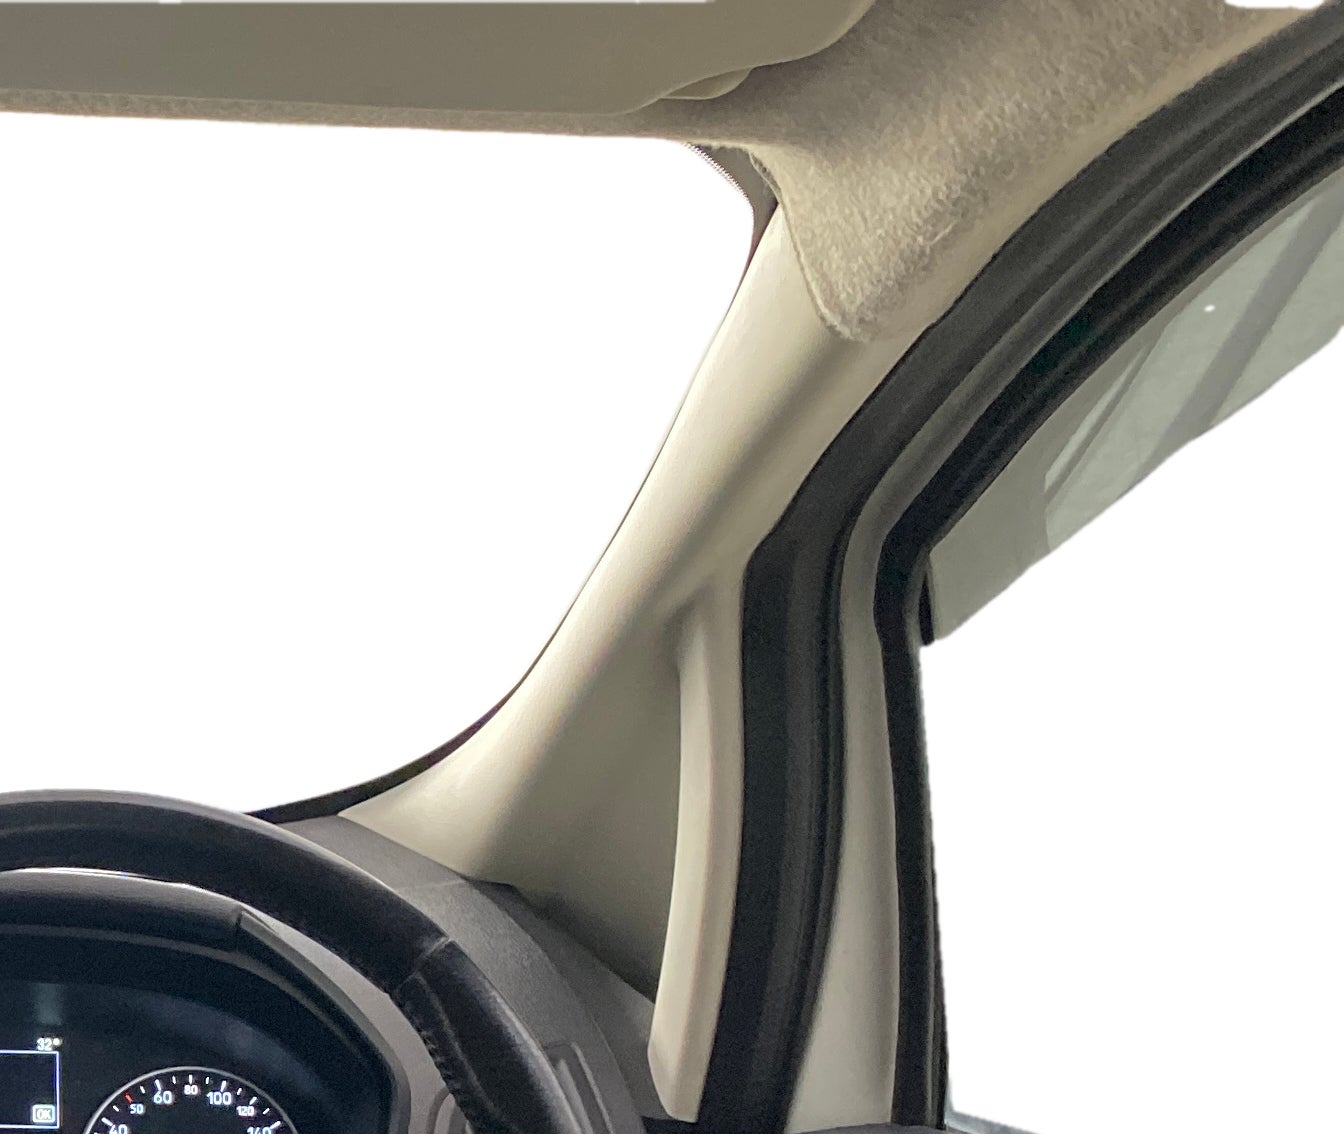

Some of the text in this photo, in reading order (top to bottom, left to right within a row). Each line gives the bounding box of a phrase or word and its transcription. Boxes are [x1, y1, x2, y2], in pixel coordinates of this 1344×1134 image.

[183, 1084, 199, 1095] 80
[153, 1090, 173, 1105] 60
[206, 1091, 232, 1106] 100
[36, 1108, 53, 1121] OK
[129, 1103, 145, 1115] 50
[236, 1105, 255, 1117] 120
